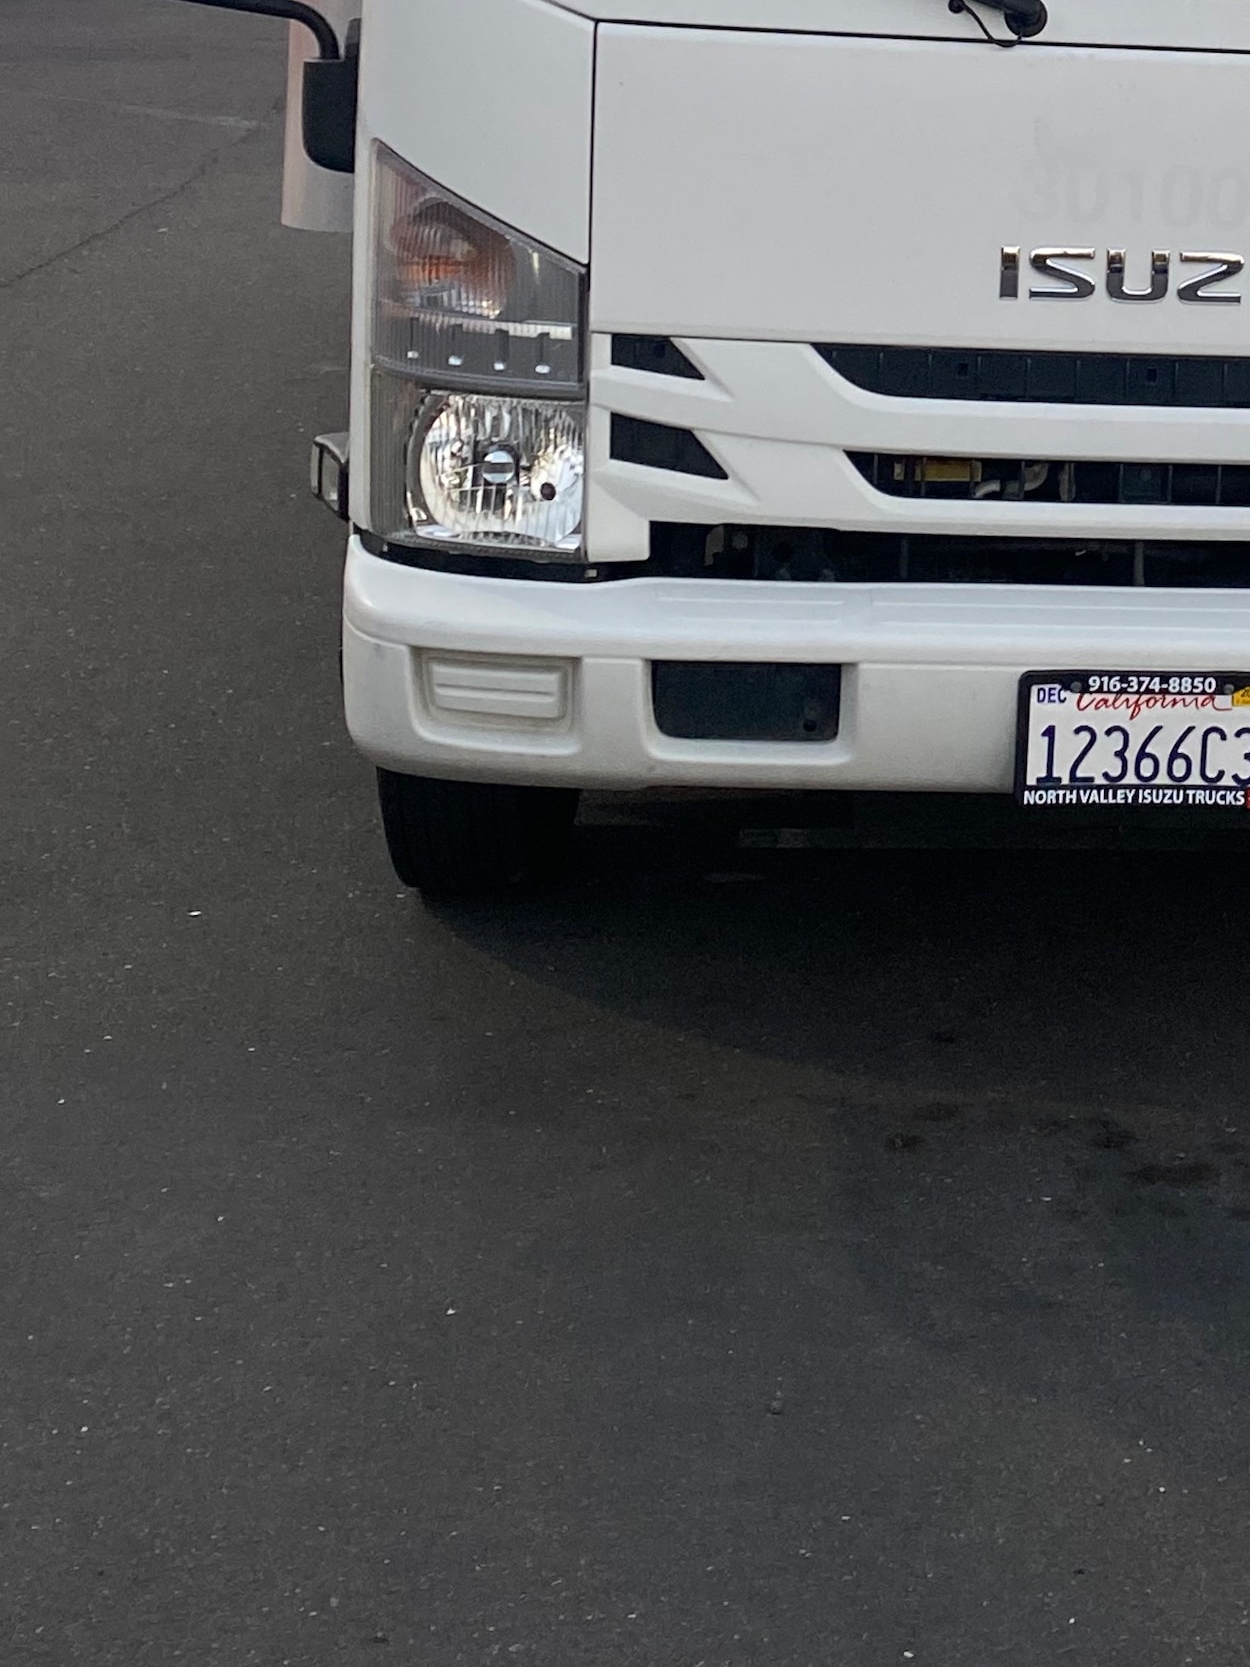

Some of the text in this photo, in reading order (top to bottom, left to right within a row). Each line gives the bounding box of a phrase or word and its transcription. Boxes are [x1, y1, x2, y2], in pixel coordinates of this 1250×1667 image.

[1088, 675, 1217, 693] 916-374-8850
[1037, 687, 1067, 703] DEC
[1076, 692, 1233, 721] California
[1023, 789, 1077, 805] NORTH
[1079, 789, 1135, 805] VALLEY
[1138, 789, 1183, 805] ISUZU
[1185, 790, 1246, 806] TRUCKS
